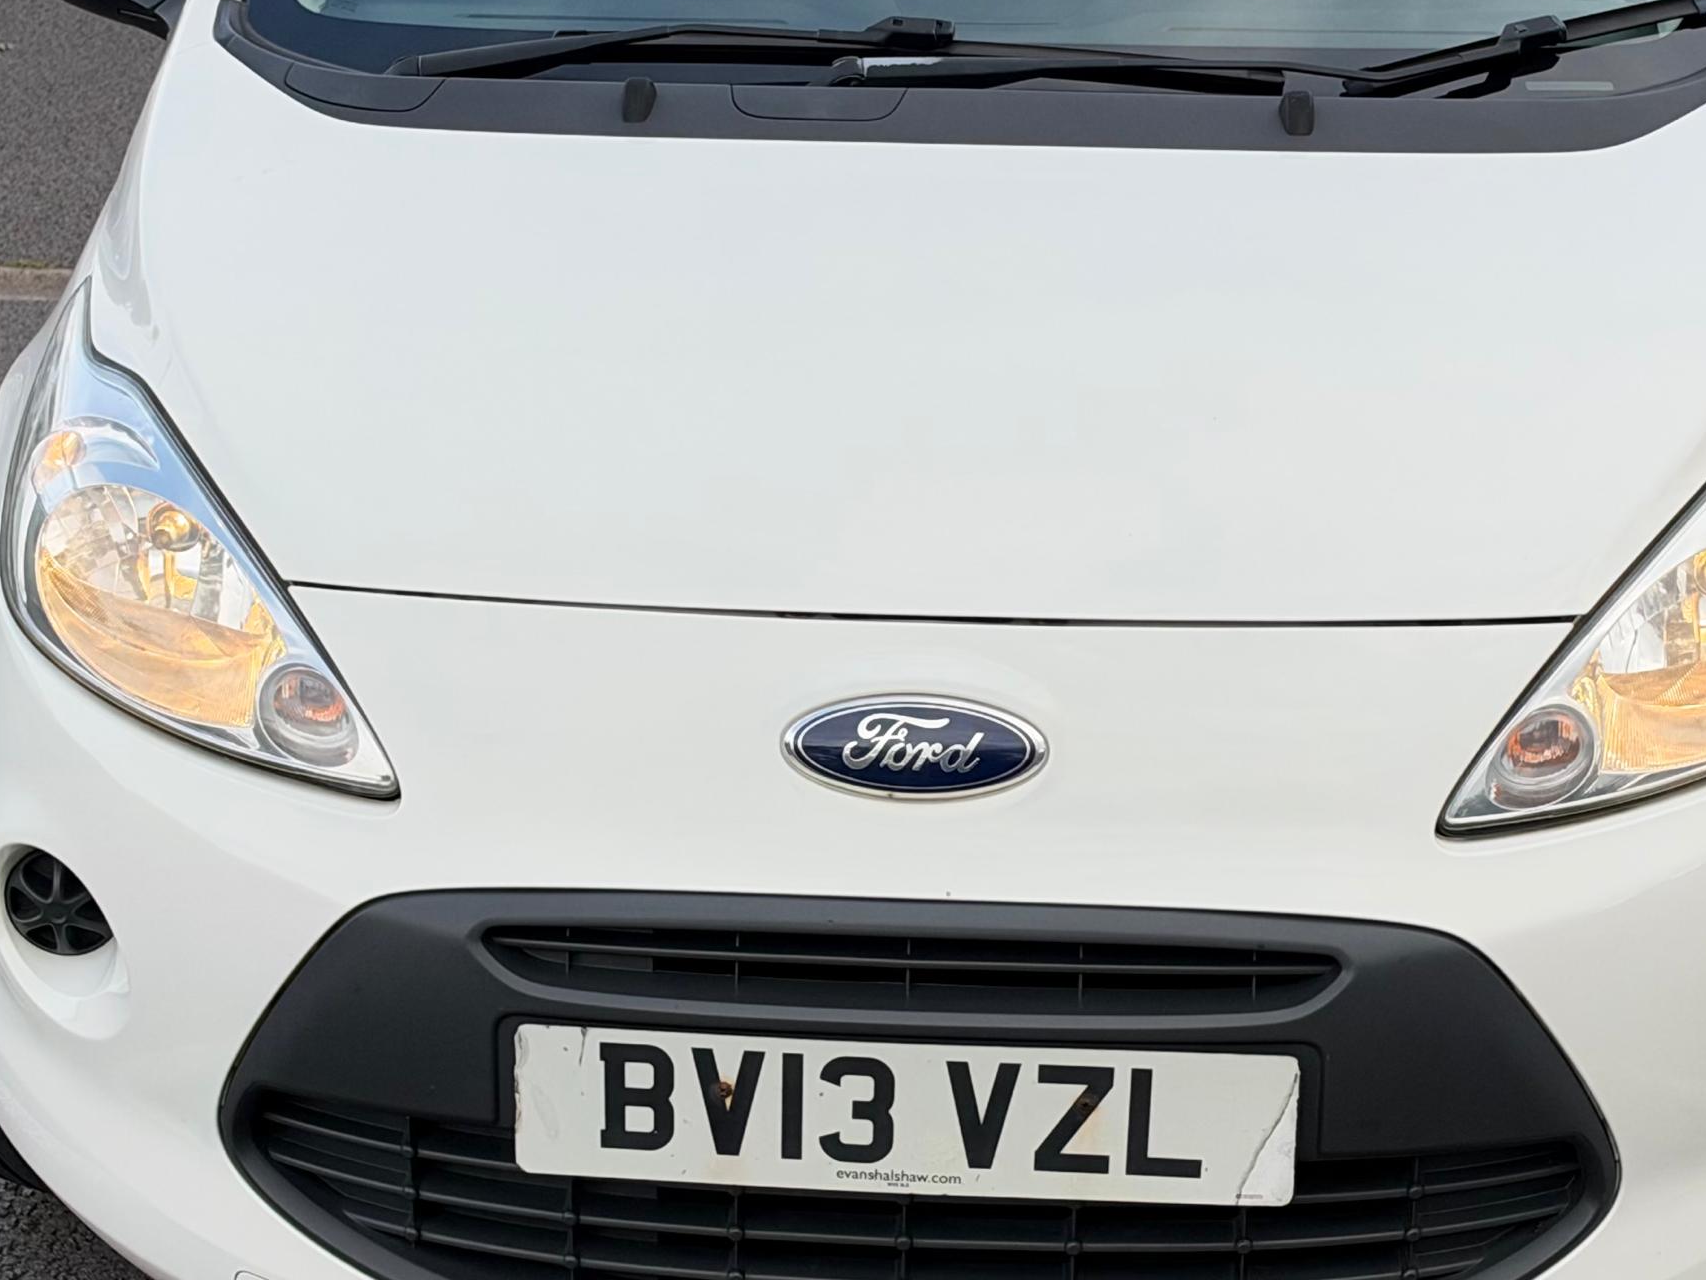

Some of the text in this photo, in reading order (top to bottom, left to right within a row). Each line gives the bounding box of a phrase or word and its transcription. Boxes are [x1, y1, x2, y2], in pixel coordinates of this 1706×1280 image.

[842, 713, 985, 774] Ford
[598, 1041, 1203, 1179] BV13 VZL
[836, 1168, 962, 1185] evanshalshaw.com
